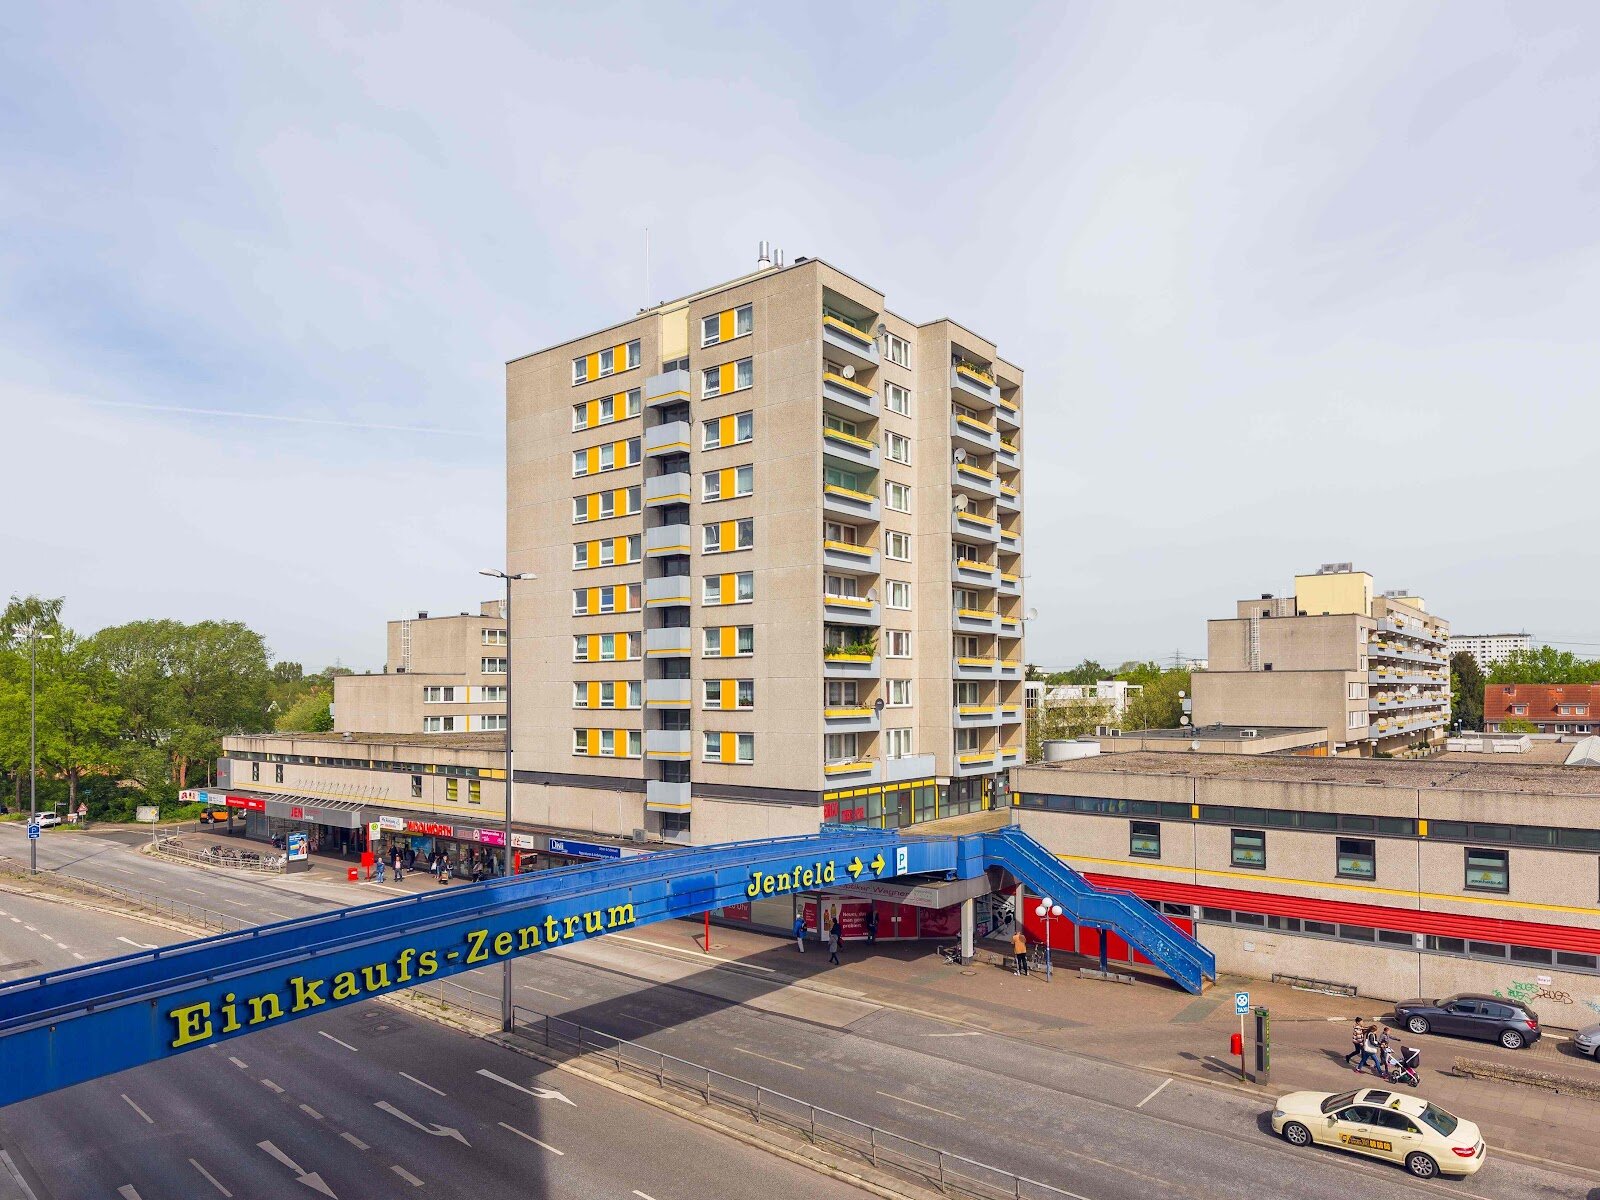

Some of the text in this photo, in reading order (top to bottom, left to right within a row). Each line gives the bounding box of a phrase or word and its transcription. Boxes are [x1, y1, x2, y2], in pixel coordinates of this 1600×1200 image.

[291, 806, 303, 819] JEN
[900, 853, 905, 866] P
[873, 886, 910, 897] Wagner
[170, 861, 835, 1047] Einkaufs-Zentrum Jenfeld
